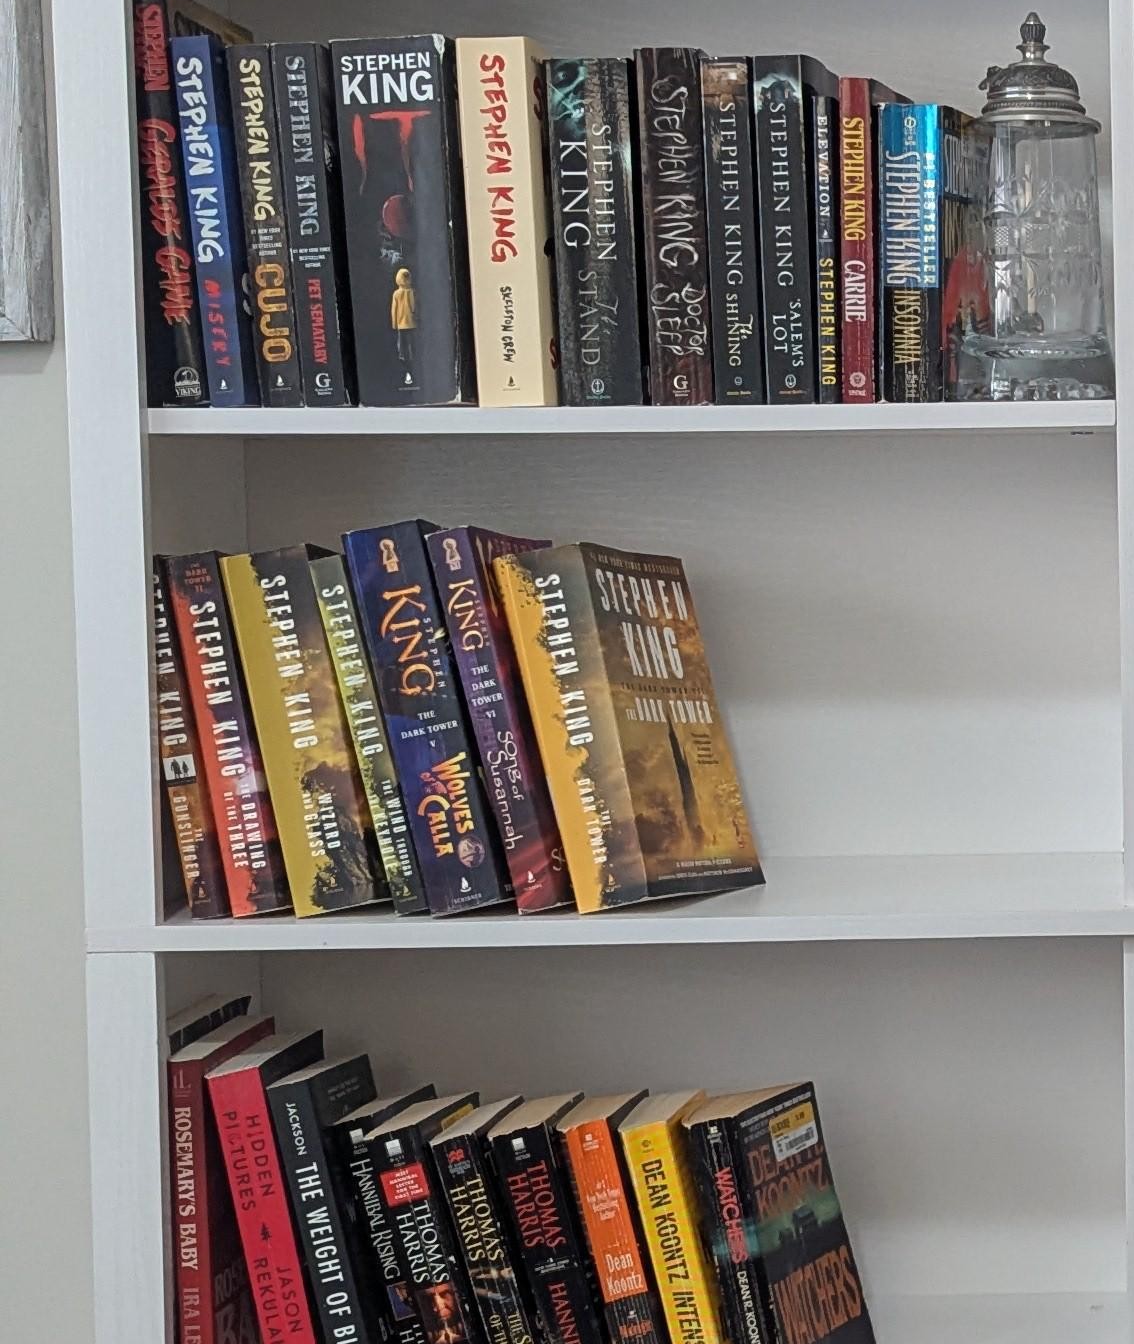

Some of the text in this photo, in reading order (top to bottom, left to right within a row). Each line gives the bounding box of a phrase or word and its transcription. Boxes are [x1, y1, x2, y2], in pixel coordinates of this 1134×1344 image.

[341, 51, 431, 72] STEPHEN
[342, 70, 435, 105] KING
[239, 57, 270, 155] STEPHEN
[353, 110, 432, 194] IT
[480, 53, 518, 265] STEPHEN KING
[841, 115, 866, 241] STEPHEN KING
[248, 160, 275, 221] KING
[254, 263, 291, 363] CUJO
[500, 286, 513, 363] SKELETON CREW
[843, 259, 868, 324] CARRIE
[595, 569, 689, 619] STEPHEN
[381, 586, 435, 696] KING
[535, 575, 595, 747] STEPHEN KING
[621, 622, 684, 679] KING
[418, 794, 454, 858] CALLA
[433, 752, 473, 835] WOLVES
[285, 1102, 307, 1156] JACKSON
[174, 1106, 197, 1271] ROSEMARY'S BABY
[295, 1162, 324, 1202] THE
[641, 1160, 671, 1209] DEAN
[307, 1207, 344, 1285] WEIGHT
[654, 1213, 689, 1284] KOONTZ
[327, 1292, 351, 1317] OF
